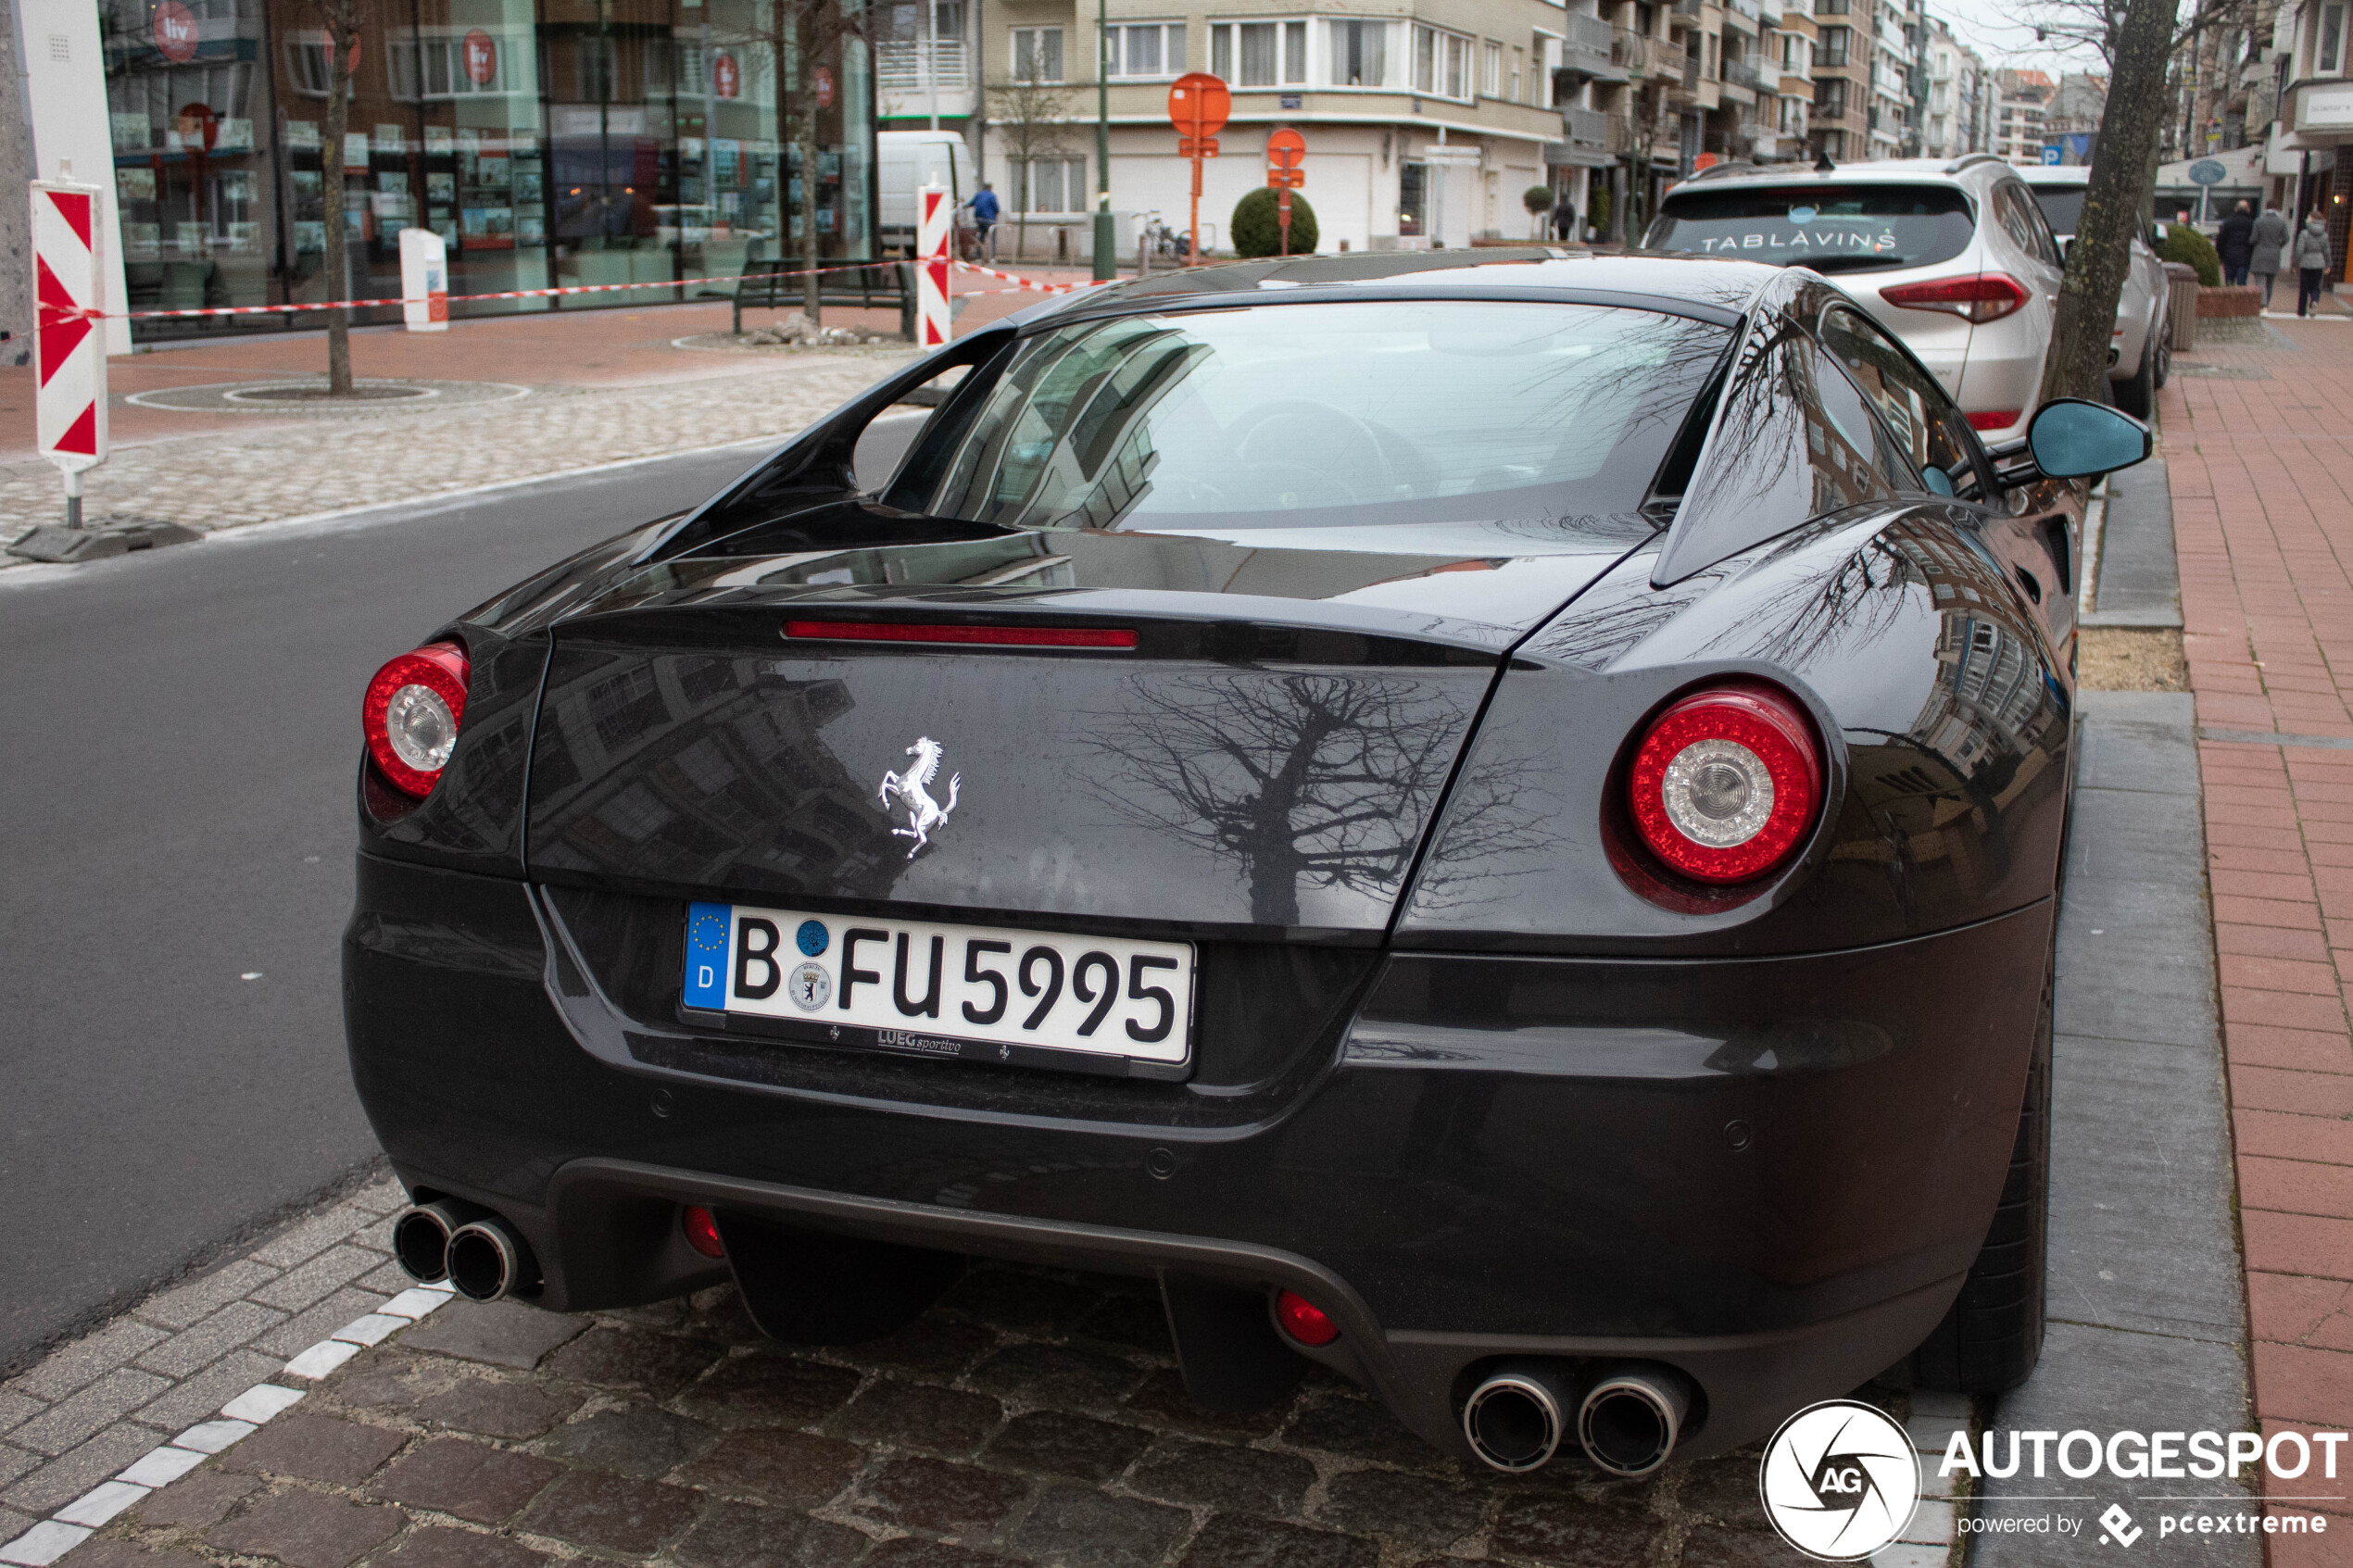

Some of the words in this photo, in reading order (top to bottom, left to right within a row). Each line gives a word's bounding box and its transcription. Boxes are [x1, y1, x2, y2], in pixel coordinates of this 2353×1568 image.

[2045, 149, 2058, 166] P
[698, 965, 713, 988] D
[734, 917, 781, 1000] B
[837, 927, 943, 1019] FU
[962, 938, 1179, 1044] 5995
[877, 1030, 915, 1047] LUEG
[916, 1038, 962, 1052] sportivo
